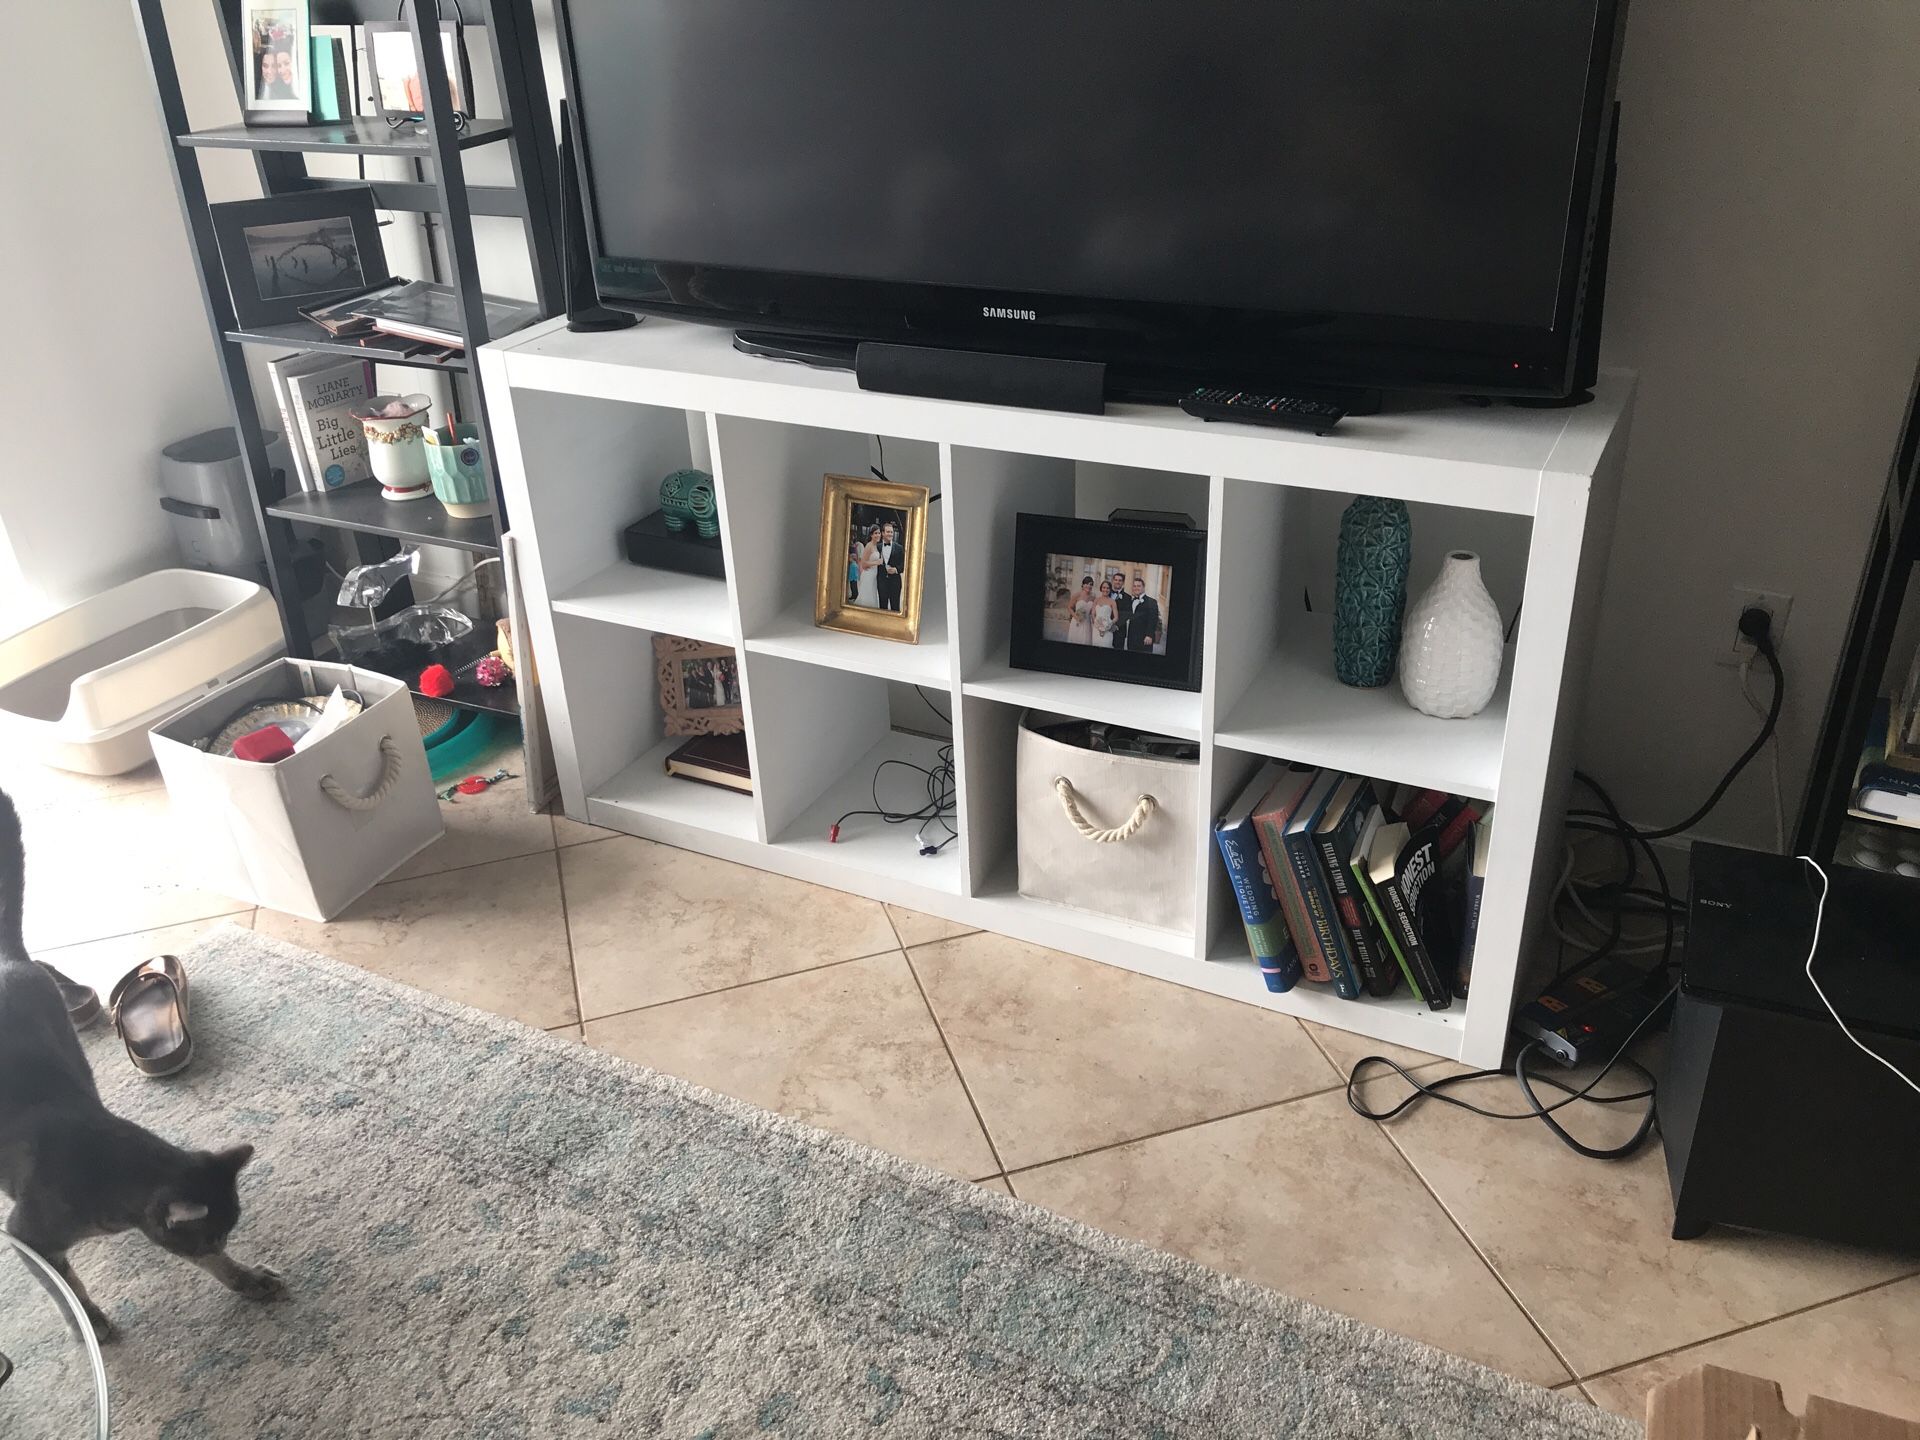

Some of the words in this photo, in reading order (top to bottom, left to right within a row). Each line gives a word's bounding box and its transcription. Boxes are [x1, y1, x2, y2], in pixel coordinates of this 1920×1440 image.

[983, 306, 1036, 320] SAMSUNG
[307, 385, 364, 410] MORIARTY
[316, 377, 350, 395] LIANE
[316, 417, 339, 432] Big
[317, 427, 355, 450] Little
[330, 444, 357, 461] Lies
[1322, 842, 1339, 868] KILLING
[1331, 869, 1348, 895] LINCOLN
[1234, 875, 1254, 920] ETIQUETTE
[1243, 877, 1260, 917] WEDDING
[1700, 899, 1732, 909] SONY
[1388, 886, 1404, 911] HONEST
[1398, 911, 1419, 947] SEDUCTION
[1316, 919, 1345, 978] BIRTHDAYS
